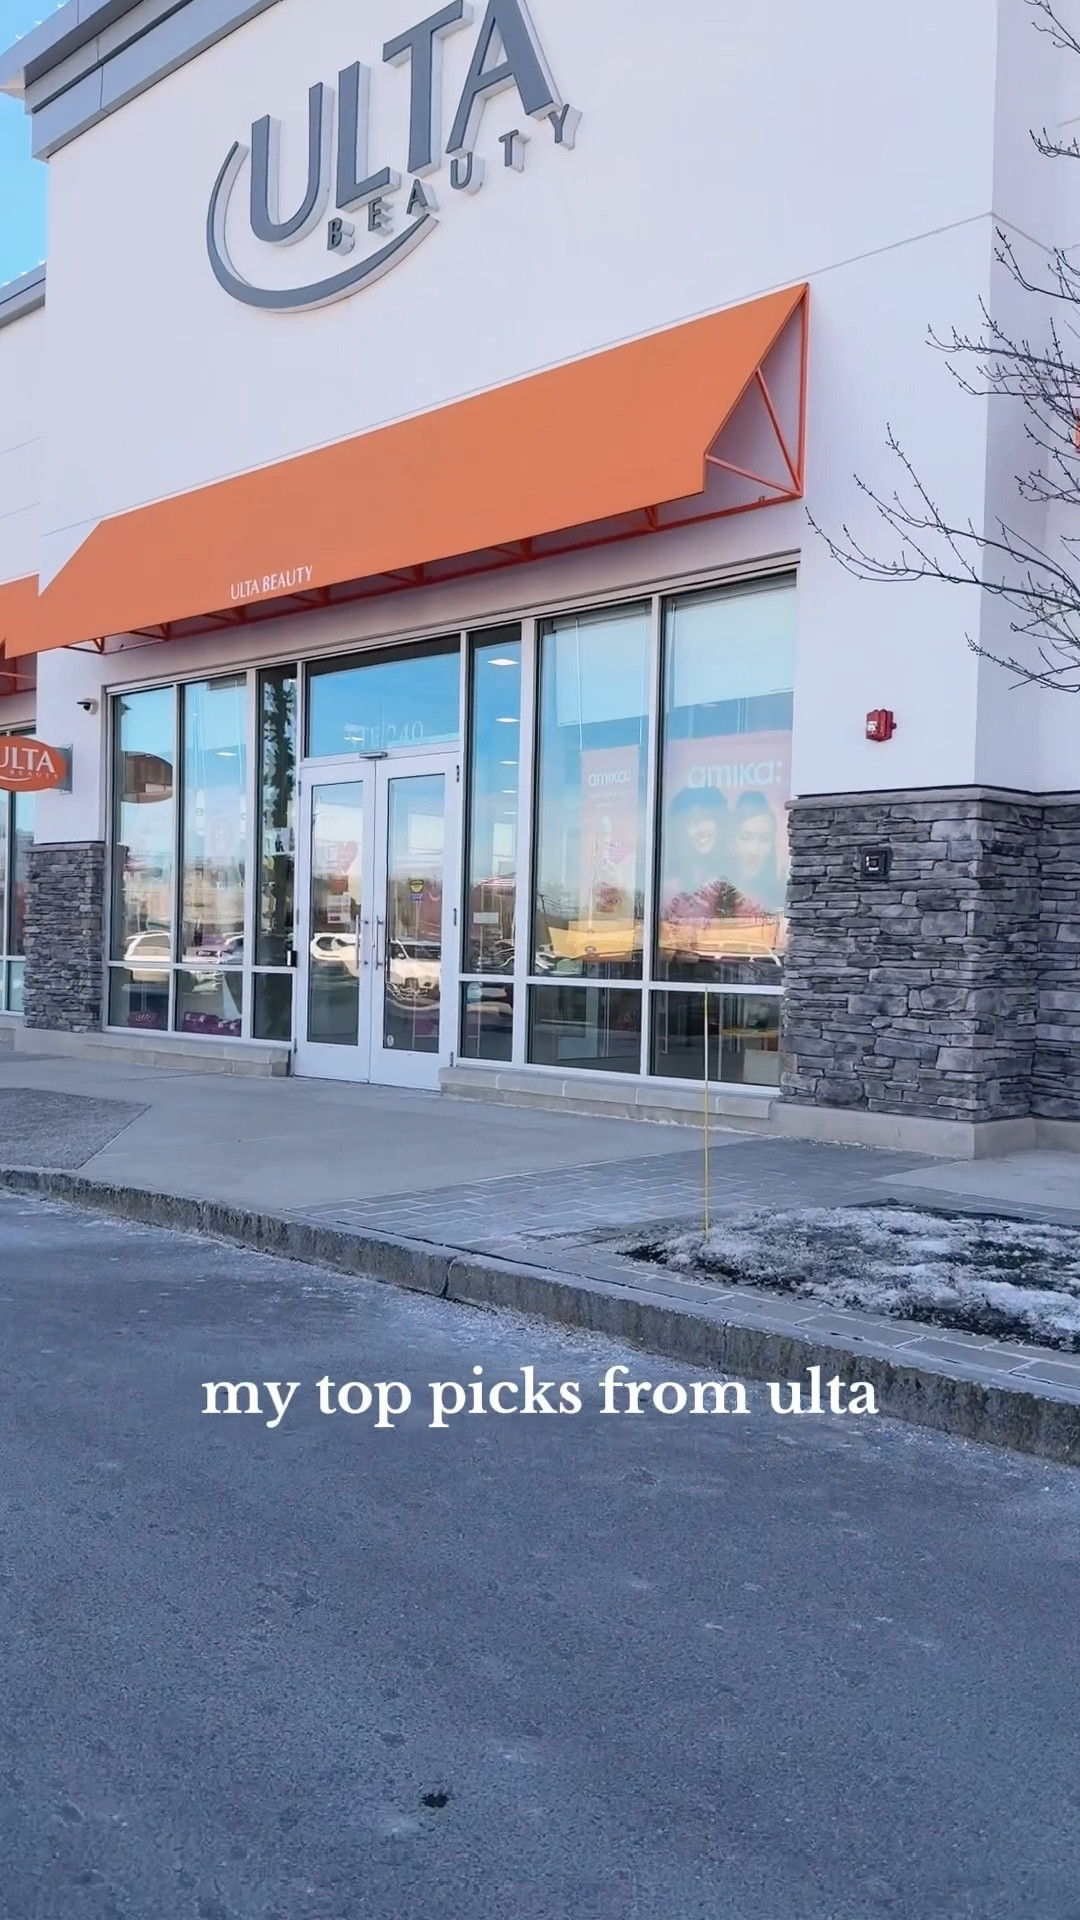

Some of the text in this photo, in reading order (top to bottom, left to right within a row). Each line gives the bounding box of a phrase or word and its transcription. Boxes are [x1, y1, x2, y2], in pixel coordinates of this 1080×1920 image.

[250, 0, 557, 244] ULTA
[326, 104, 580, 254] BEAUTY
[230, 564, 313, 600] ULTA BEAUTY
[386, 720, 424, 748] 240
[588, 768, 632, 787] amika:
[687, 760, 783, 790] amika:
